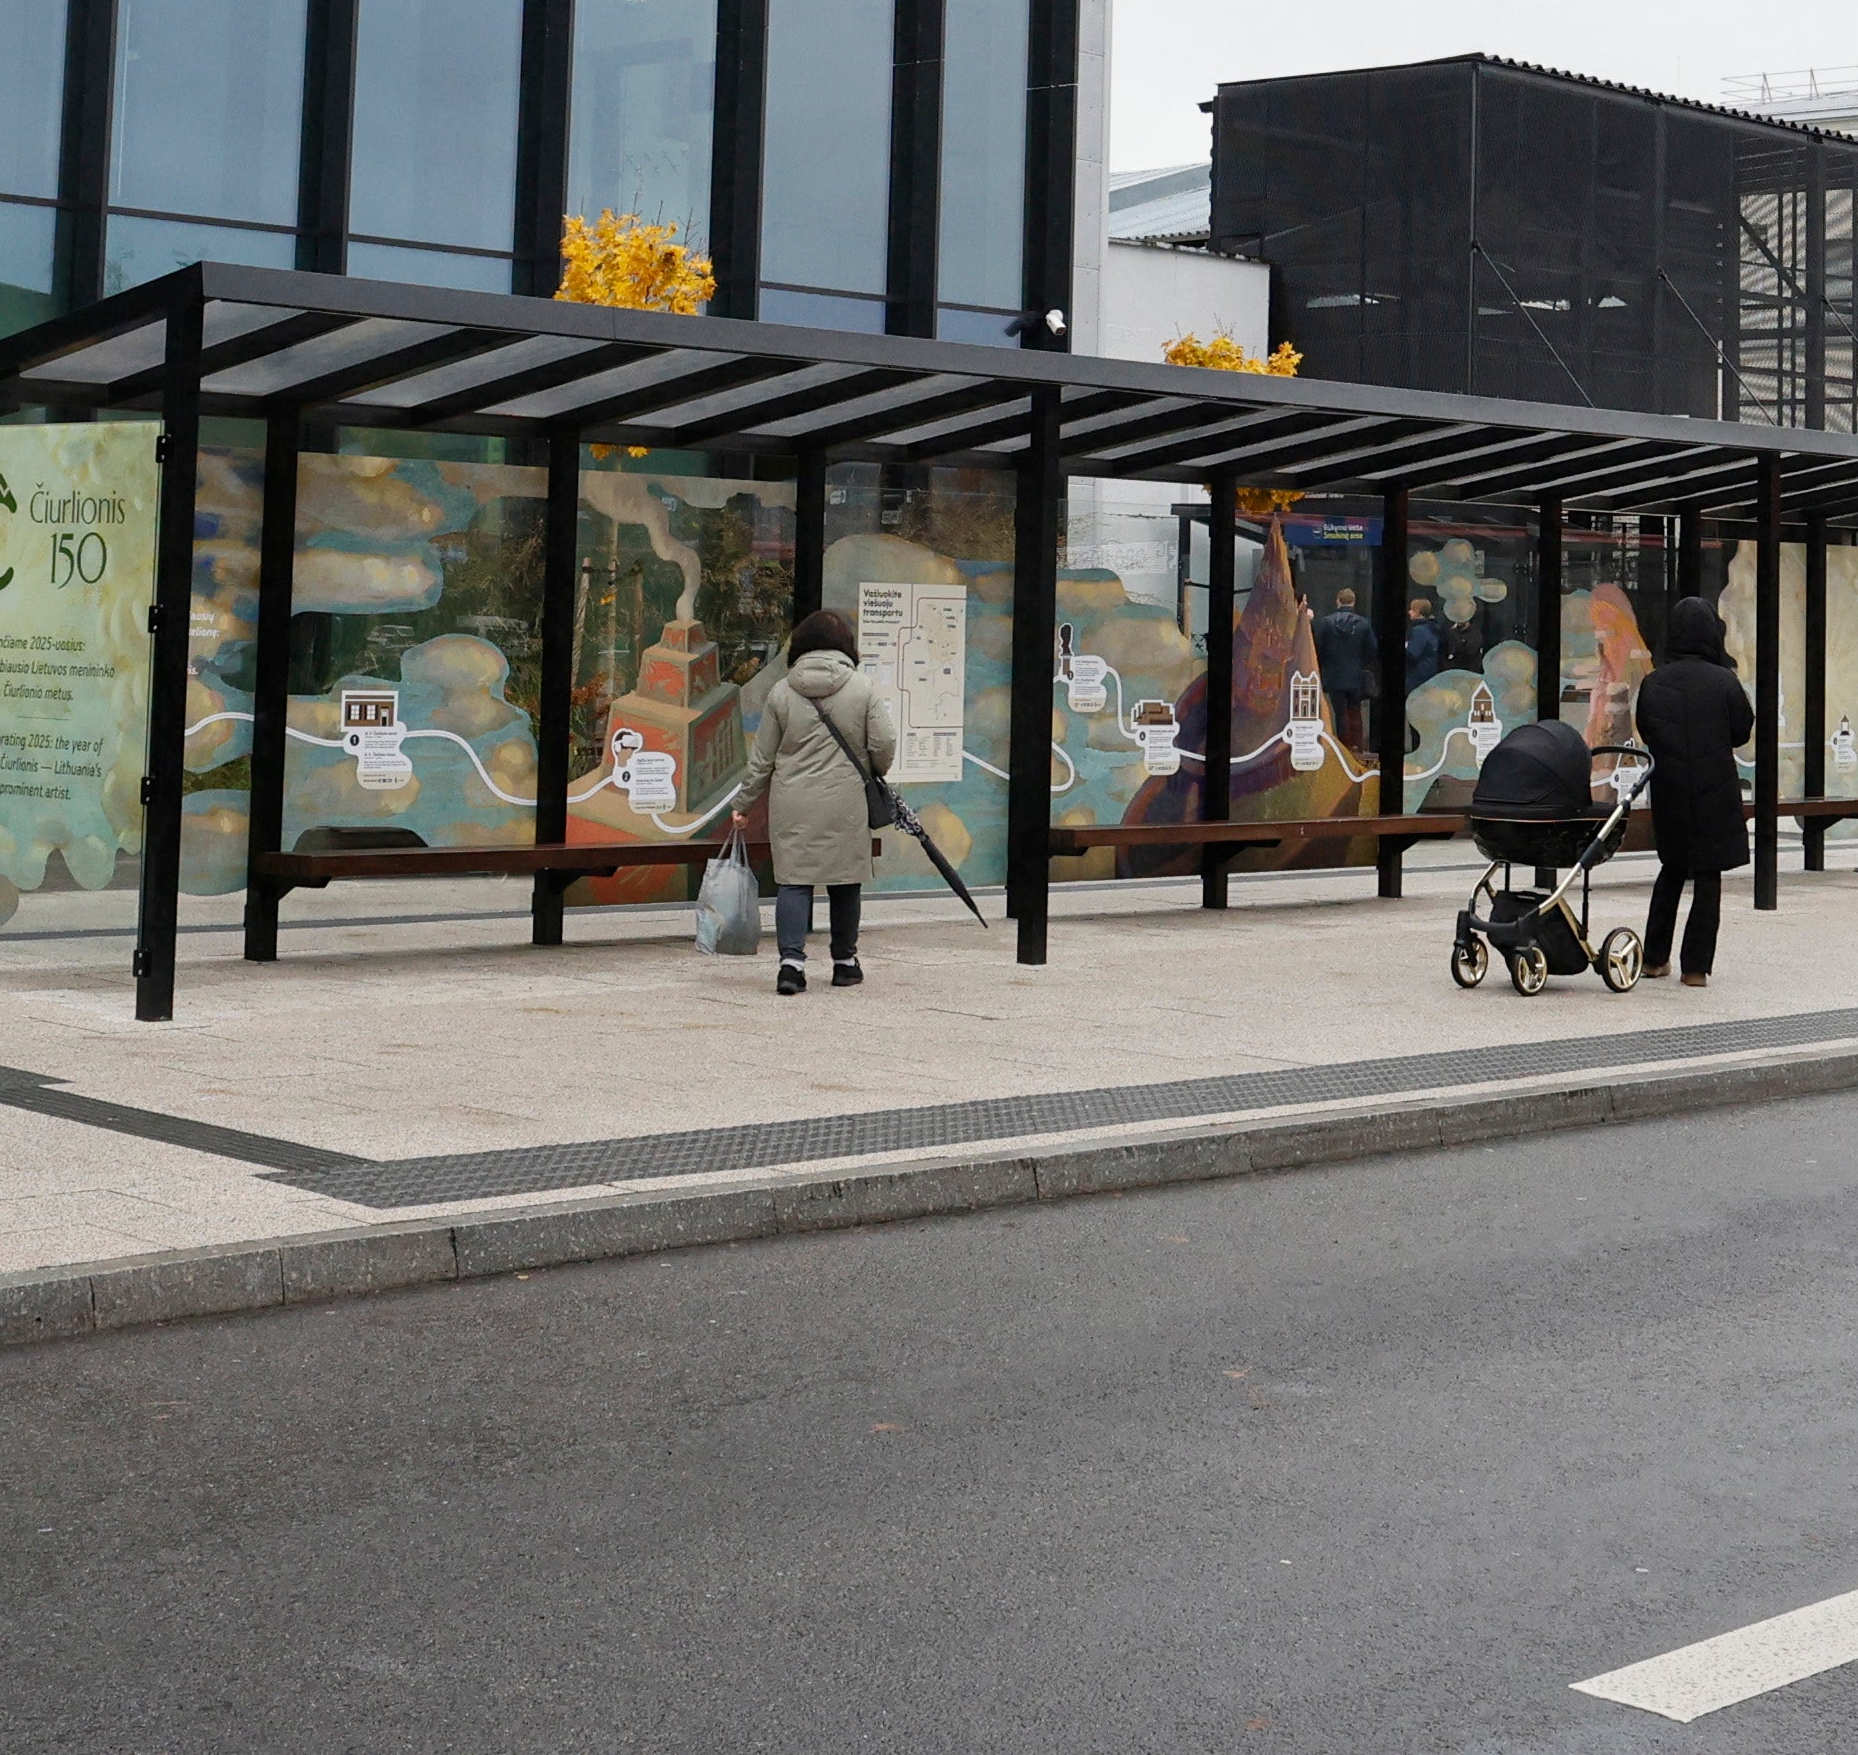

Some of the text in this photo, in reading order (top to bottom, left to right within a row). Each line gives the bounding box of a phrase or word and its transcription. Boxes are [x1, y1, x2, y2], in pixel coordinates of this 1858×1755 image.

[30, 482, 125, 524] Čiurlionis
[1323, 532, 1349, 540] Smoking
[50, 532, 107, 589] 150
[863, 589, 902, 598] Važiuokite
[863, 598, 893, 609] viešuoju
[862, 609, 903, 618] transportu
[30, 636, 86, 651] 2025-uosius:
[31, 660, 67, 676] Lietuvos
[69, 663, 115, 678] menininko
[3, 680, 42, 699] Čiurlionio
[44, 688, 74, 701] metus.
[27, 734, 54, 749] 2025:
[55, 735, 69, 750] the
[72, 740, 91, 754] year
[93, 738, 104, 756] of
[0, 753, 39, 773] Čiurlionis
[54, 761, 102, 778] Lithuania's
[0, 782, 43, 798] prominent
[44, 786, 72, 800] artist.
